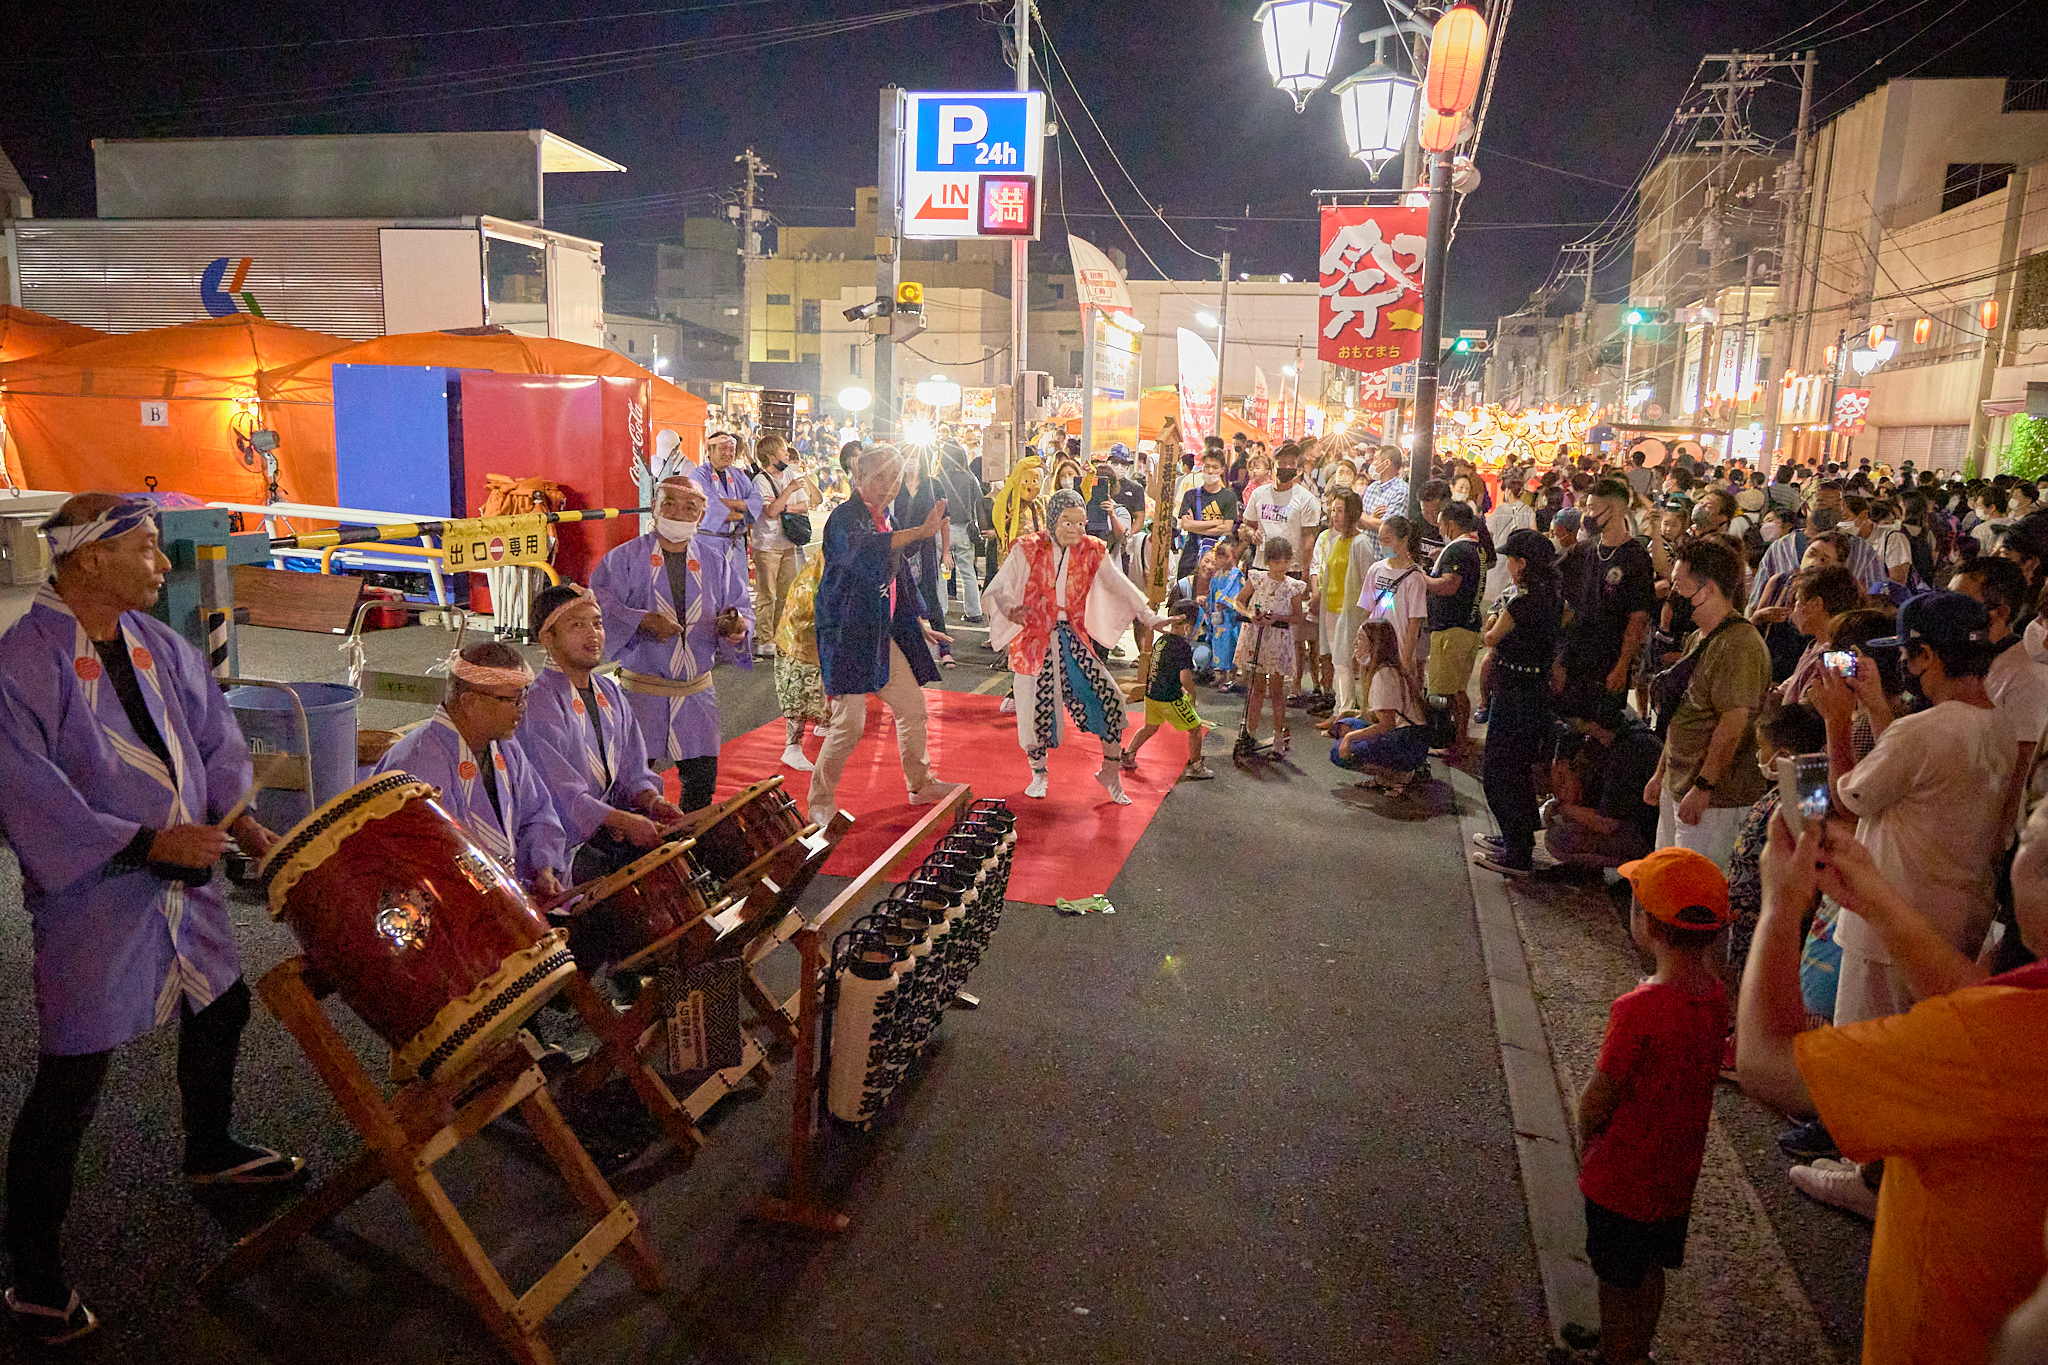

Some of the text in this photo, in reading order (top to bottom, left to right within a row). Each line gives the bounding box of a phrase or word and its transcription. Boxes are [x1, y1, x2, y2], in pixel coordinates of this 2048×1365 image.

[937, 104, 989, 165] P
[974, 141, 1017, 165] 24h
[942, 184, 970, 205] IN
[988, 187, 1024, 223] 満
[1319, 218, 1427, 340] 祭
[1338, 345, 1401, 359] おもてまち
[1404, 359, 1416, 394] 商店街
[150, 406, 161, 422] B
[1835, 392, 1869, 427] 祭
[450, 534, 539, 566] 出口 専用
